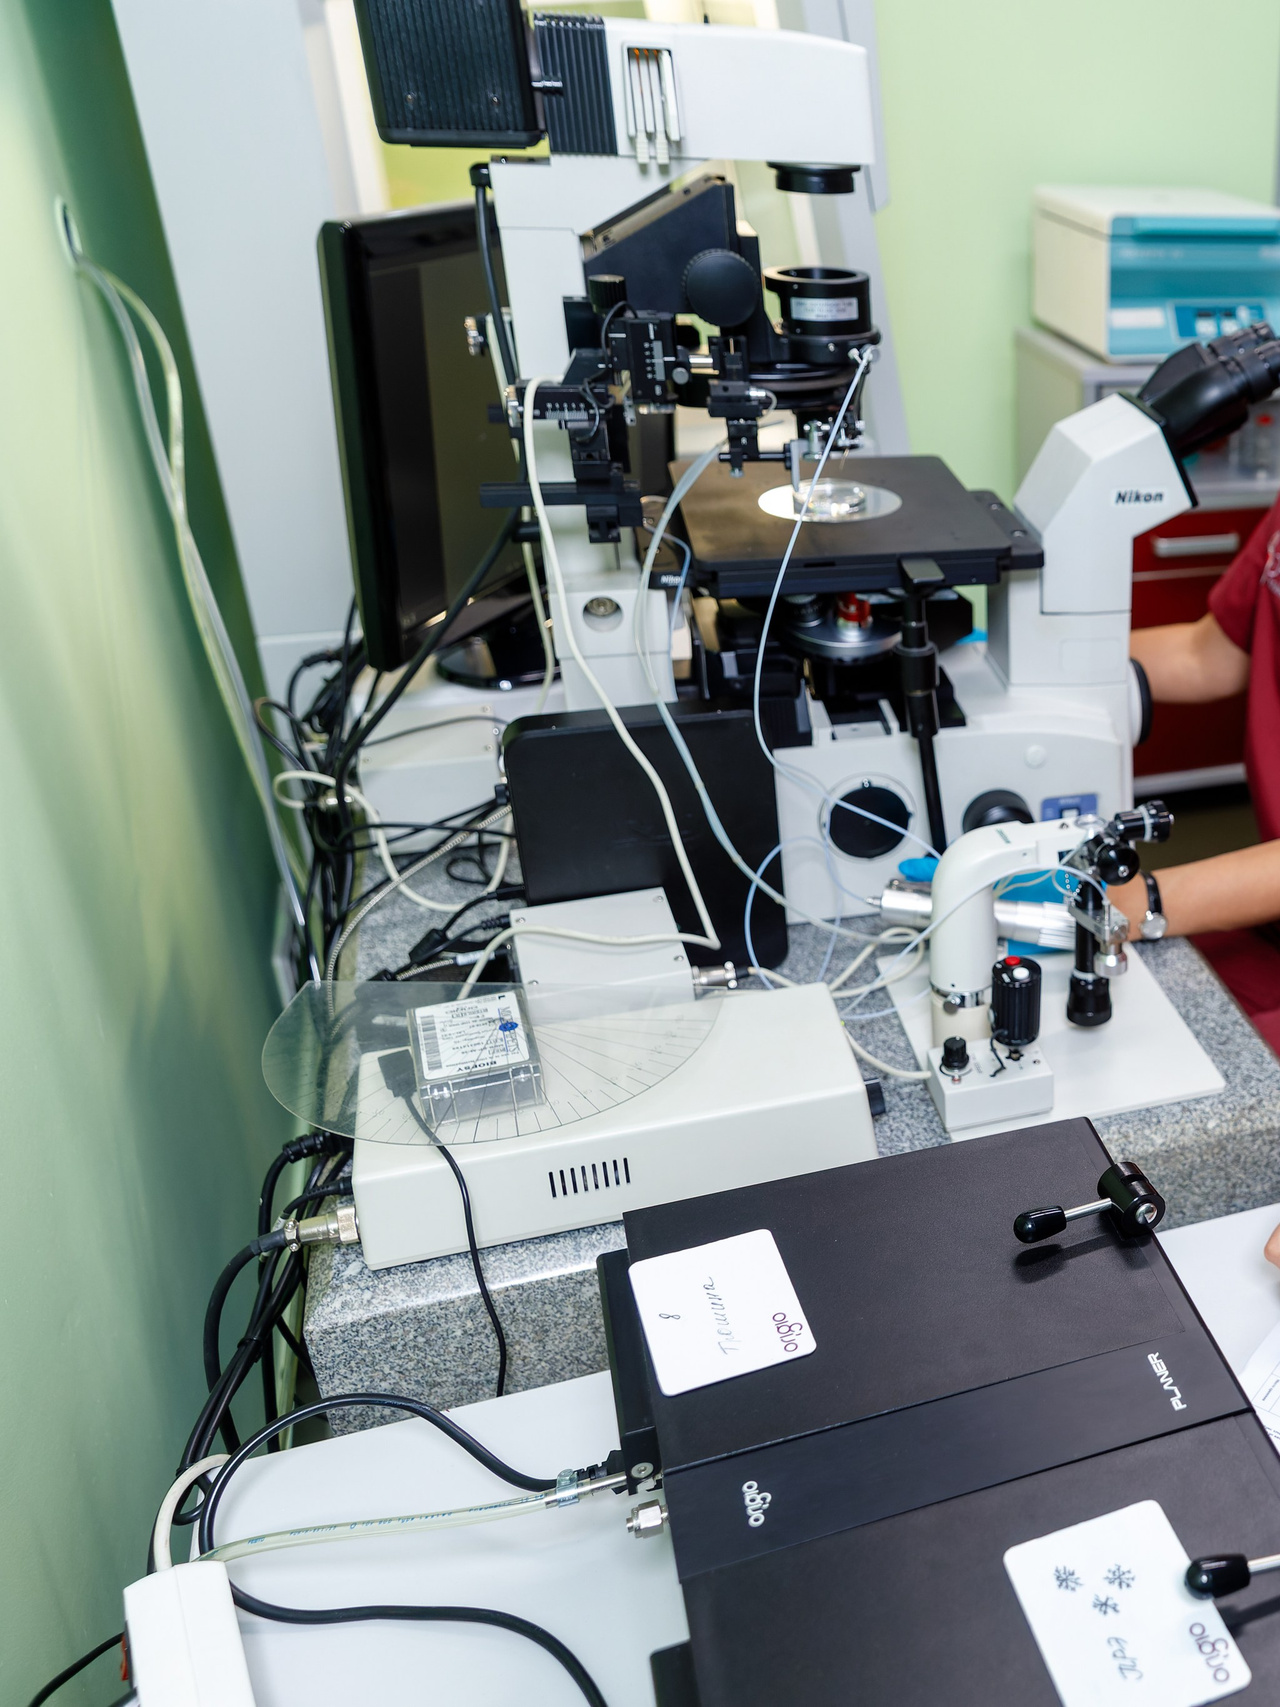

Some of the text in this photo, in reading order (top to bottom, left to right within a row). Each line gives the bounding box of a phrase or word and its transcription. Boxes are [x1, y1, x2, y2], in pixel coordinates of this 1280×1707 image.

[1115, 489, 1163, 504] Nikon
[771, 1311, 805, 1353] origio
[1146, 1351, 1187, 1412] PLANER
[740, 1479, 773, 1529] origio
[1188, 1621, 1232, 1684] origio
